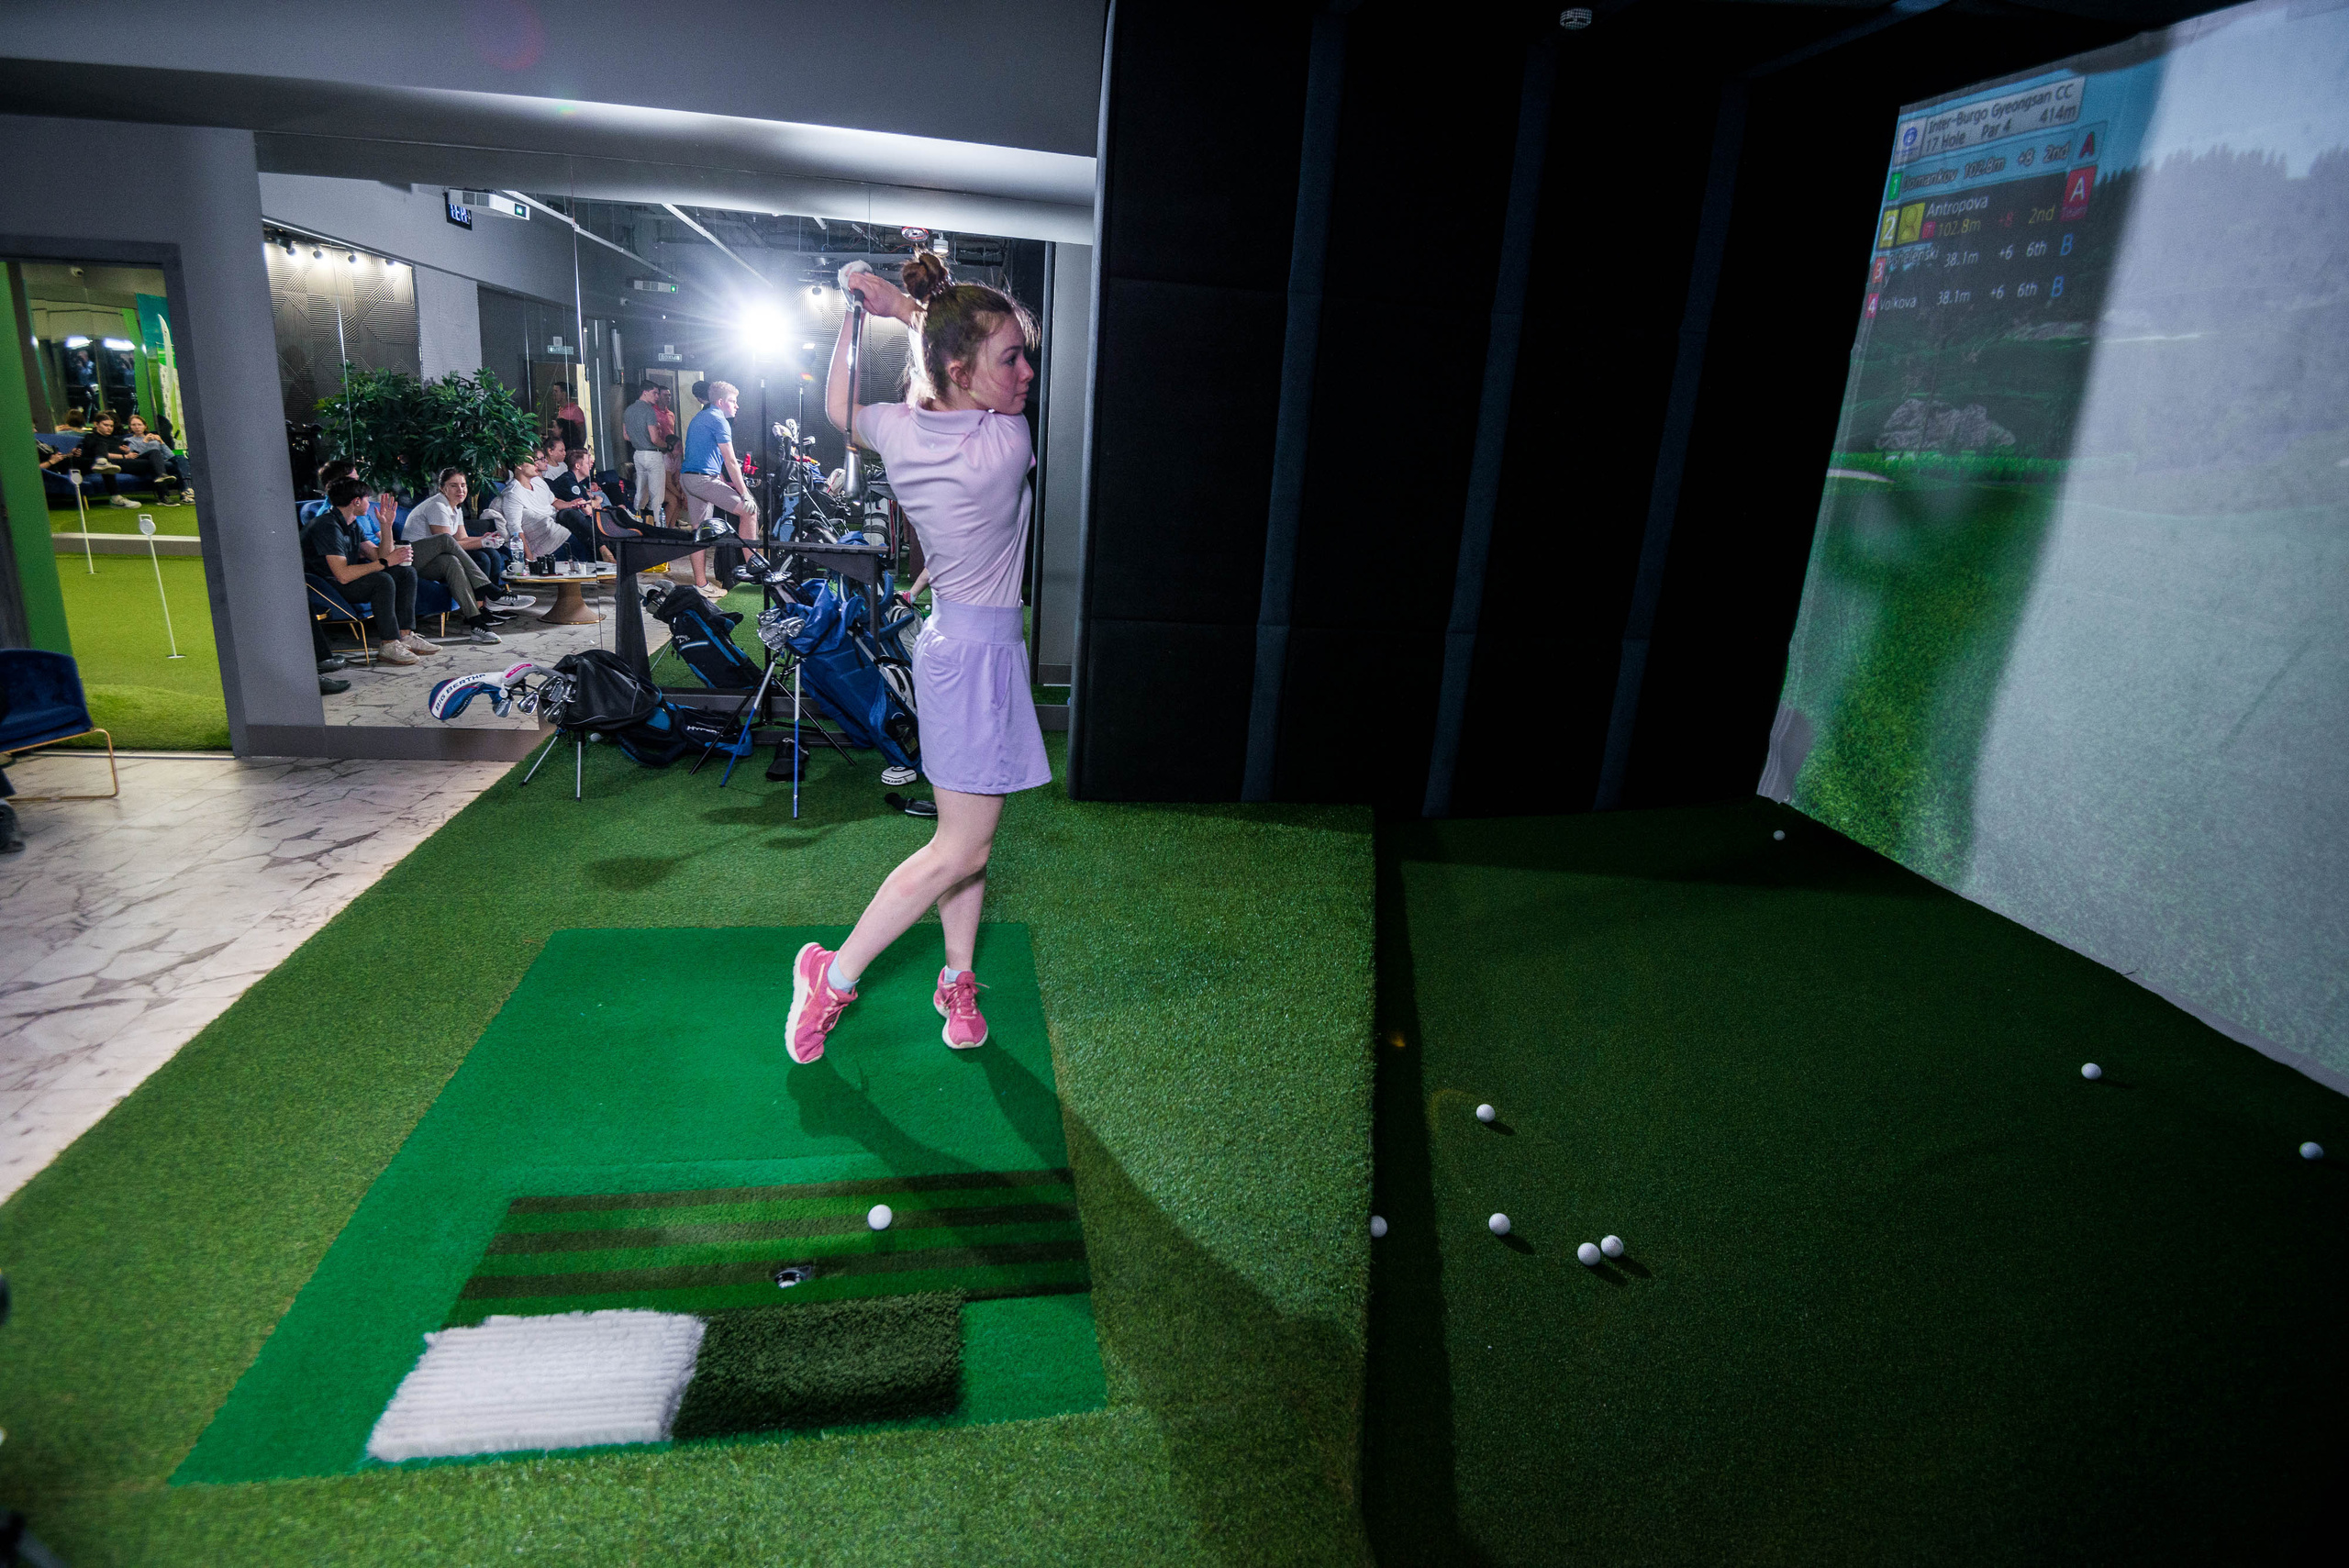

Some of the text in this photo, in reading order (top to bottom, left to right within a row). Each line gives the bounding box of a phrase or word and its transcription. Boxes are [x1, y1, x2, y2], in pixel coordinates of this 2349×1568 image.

[1928, 137, 1940, 152] 17
[1942, 131, 1966, 147] Hole
[1981, 124, 2000, 139] Par
[2002, 118, 2011, 132] 4
[2039, 105, 2077, 123] 414m
[1929, 83, 2074, 134] Inter-Burgo Gyeongsan CC
[2043, 141, 2071, 162] 2nd
[2078, 131, 2096, 159] A
[1926, 176, 2086, 217] Antropova A
[1882, 214, 1898, 240] 2
[1938, 217, 1982, 238] 102.8m
[2029, 205, 2055, 225] 2nd
[1874, 261, 1884, 280] 3
[1943, 250, 1979, 269] 38.1m
[1998, 244, 2014, 261] +6
[2026, 239, 2048, 257] 6th
[2059, 232, 2074, 257] B
[1867, 275, 2065, 315] 4 Vokova 38.1m +6 6th B
[435, 694, 446, 711] BIG
[446, 673, 485, 695] BERTHA
